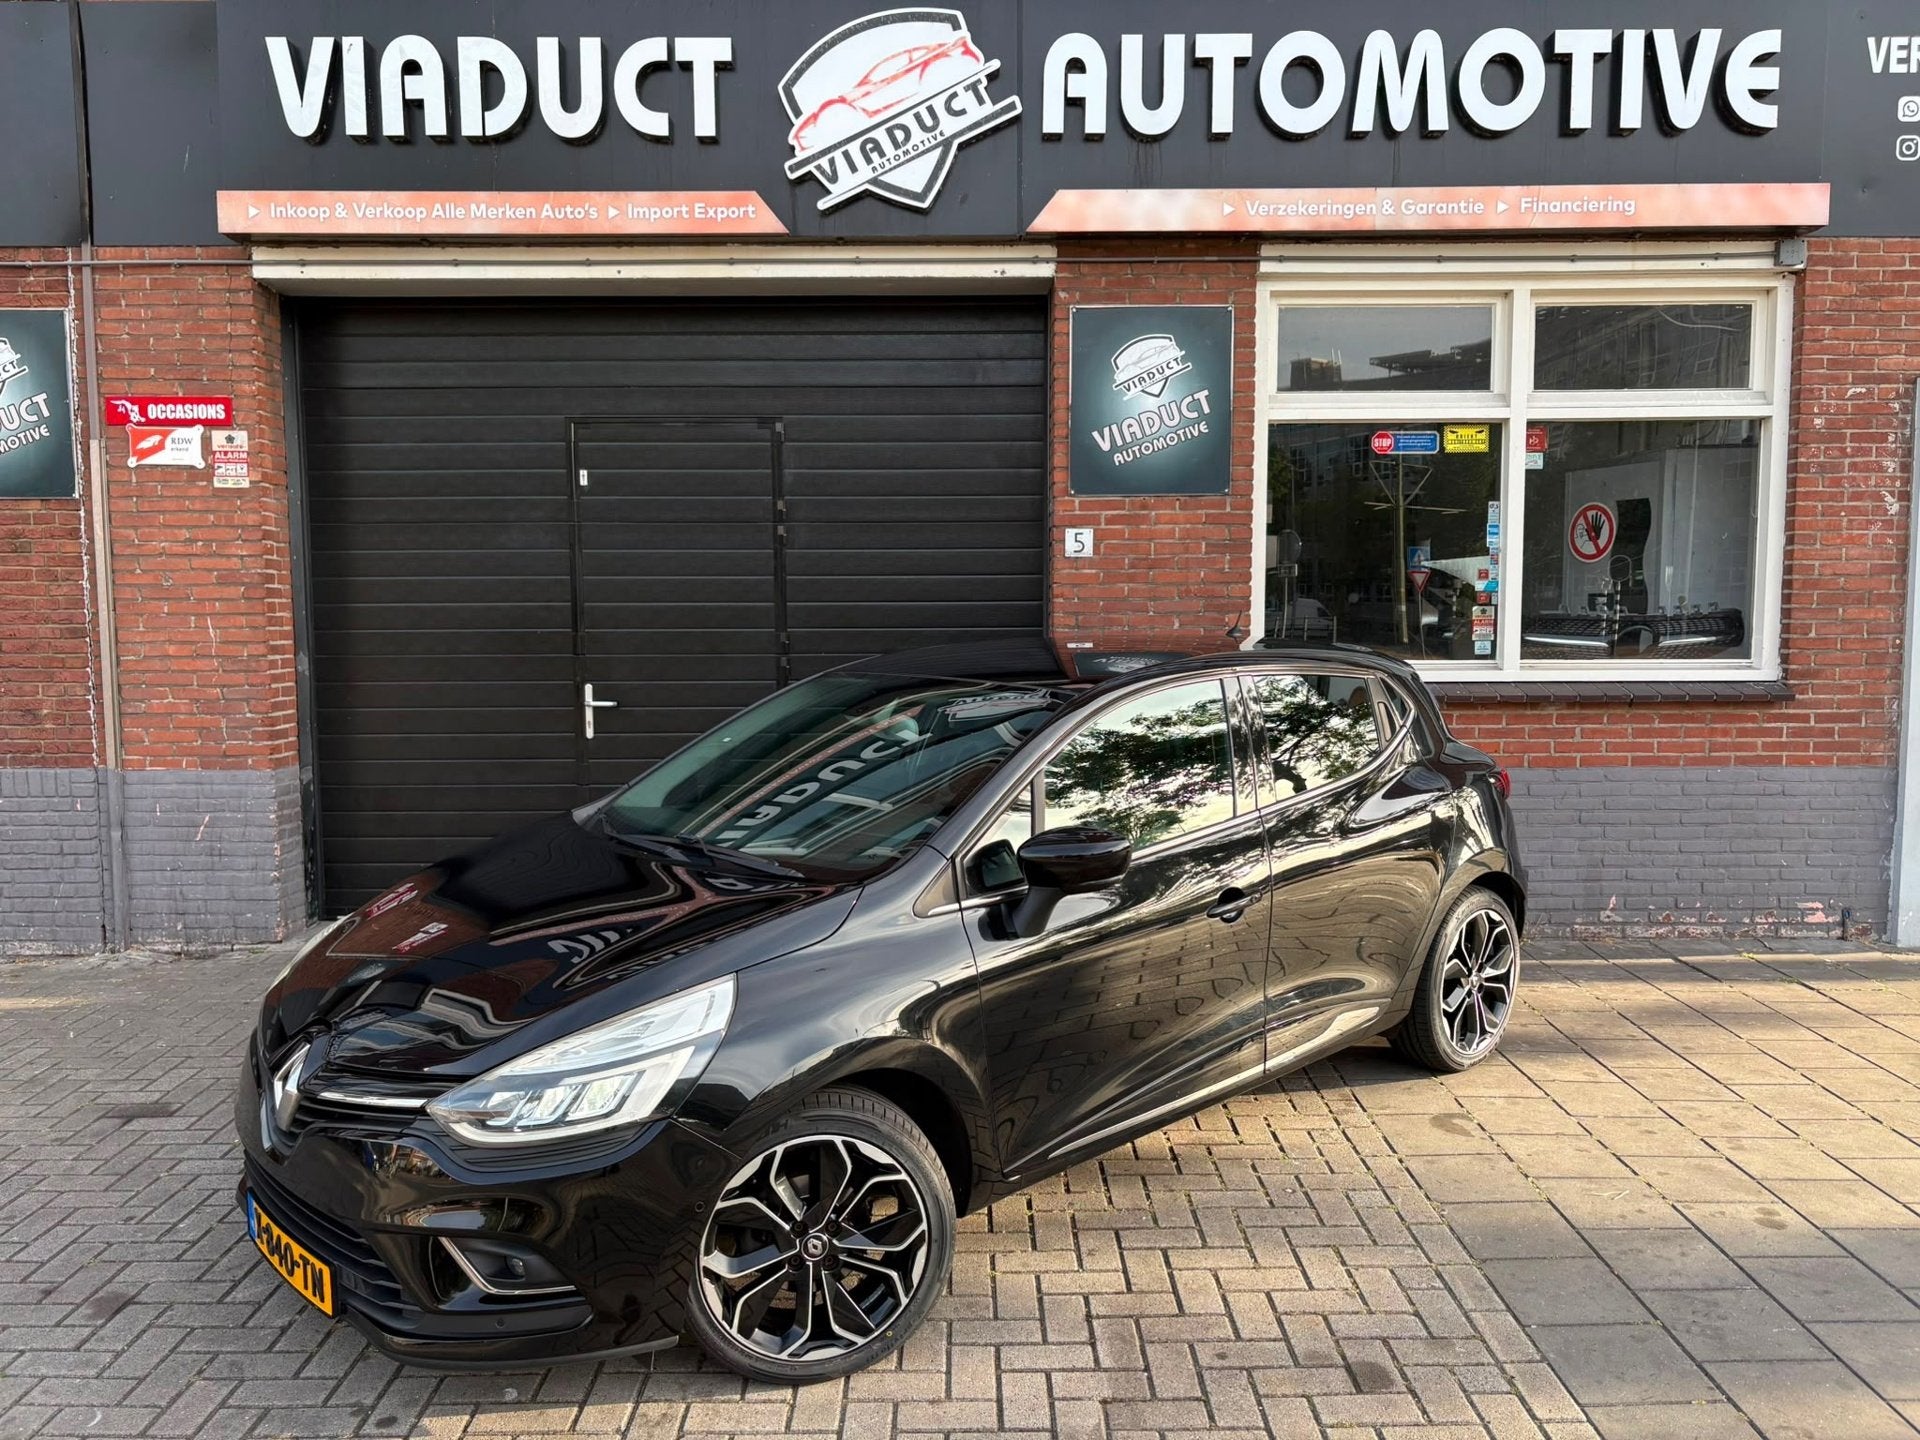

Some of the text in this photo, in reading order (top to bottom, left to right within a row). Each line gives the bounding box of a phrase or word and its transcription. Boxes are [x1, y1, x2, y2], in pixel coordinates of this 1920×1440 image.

[264, 34, 734, 139] VIADUCT
[1042, 28, 1782, 137] AUTOMOTIVE
[813, 78, 988, 185] VIADUCT
[871, 129, 946, 174] AUTOMOTIVE
[270, 202, 756, 222] Inkoop & Verkoop Alle Merken Auto's Import Export
[1246, 196, 1636, 219] Verzekeringen & Garantie Financiering
[1123, 357, 1181, 393] VIADUCT
[0, 392, 51, 433] UCT
[147, 403, 226, 420] OCCASIONS
[1092, 389, 1211, 452] VIADUCT
[170, 437, 194, 445] RDW
[214, 451, 248, 459] ALARM
[1113, 420, 1210, 466] AUTOMOTIVE
[1374, 438, 1392, 447] STOP
[1073, 532, 1085, 553] 5
